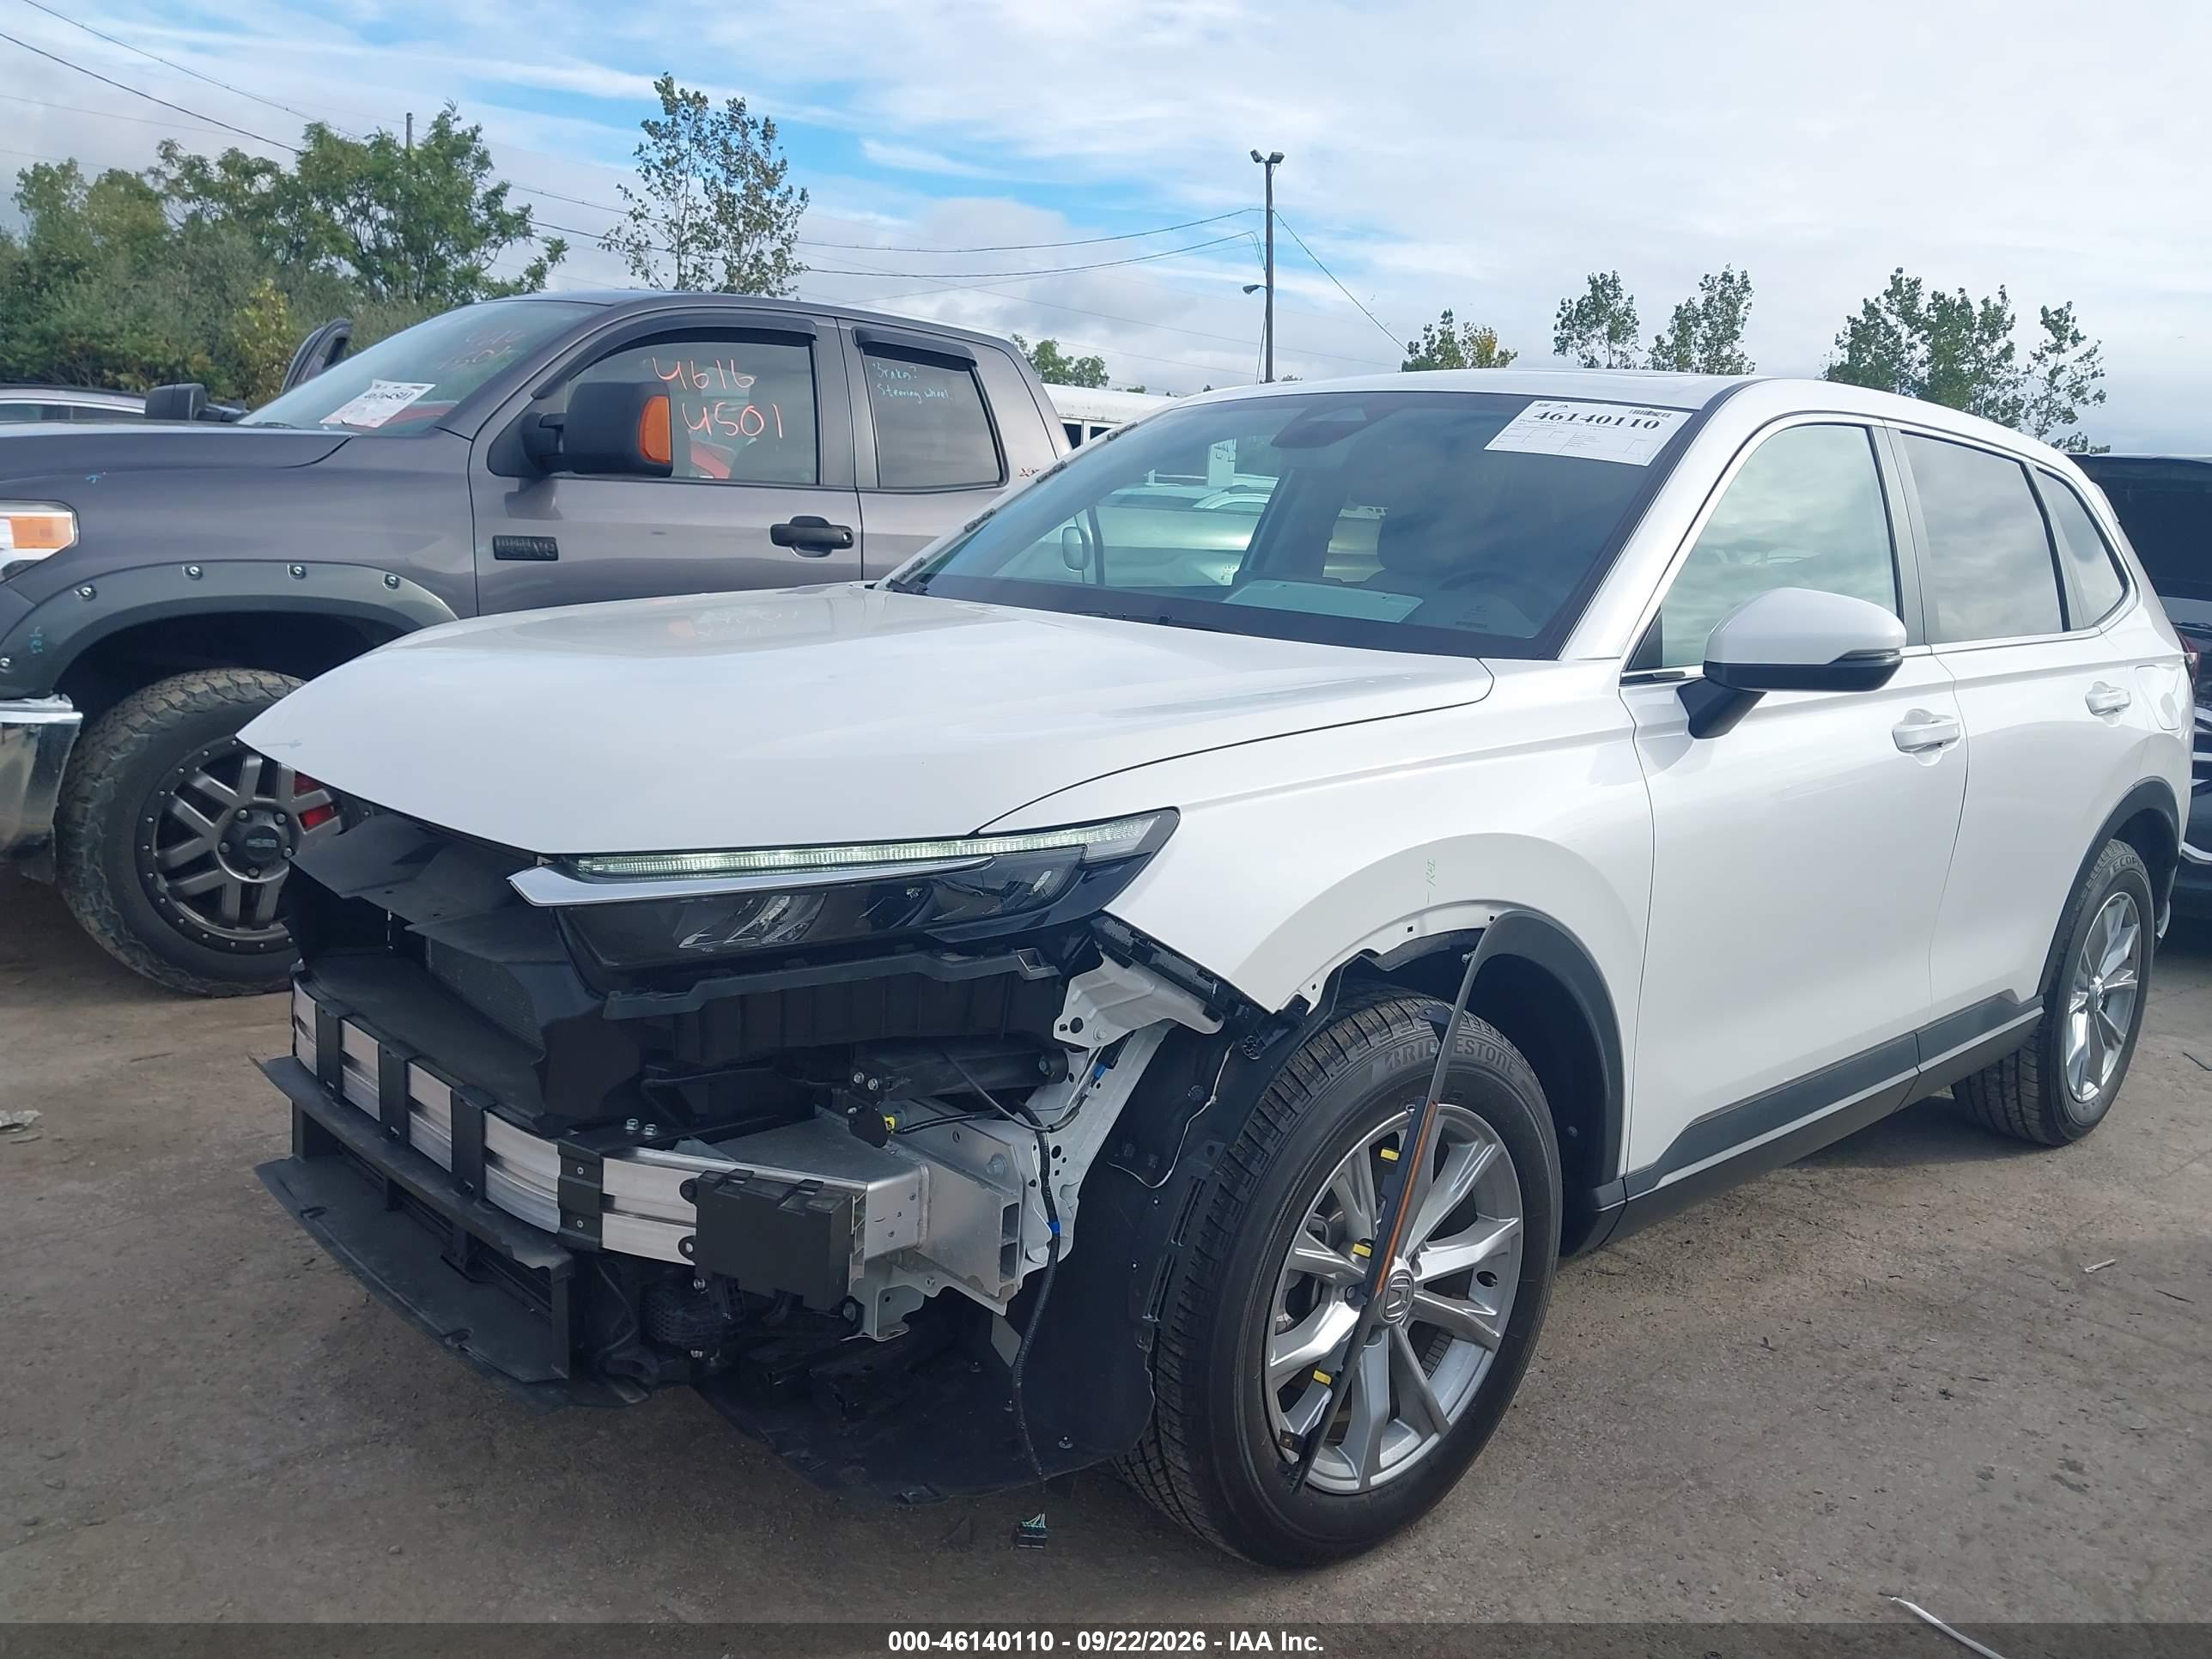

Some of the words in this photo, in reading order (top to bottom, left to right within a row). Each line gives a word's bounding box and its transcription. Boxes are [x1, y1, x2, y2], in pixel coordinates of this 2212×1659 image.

[653, 356, 757, 390] 4616
[682, 402, 782, 439] 4501
[1534, 410, 1660, 430] 46140110
[1384, 1037, 1517, 1075] BRIDESTONE
